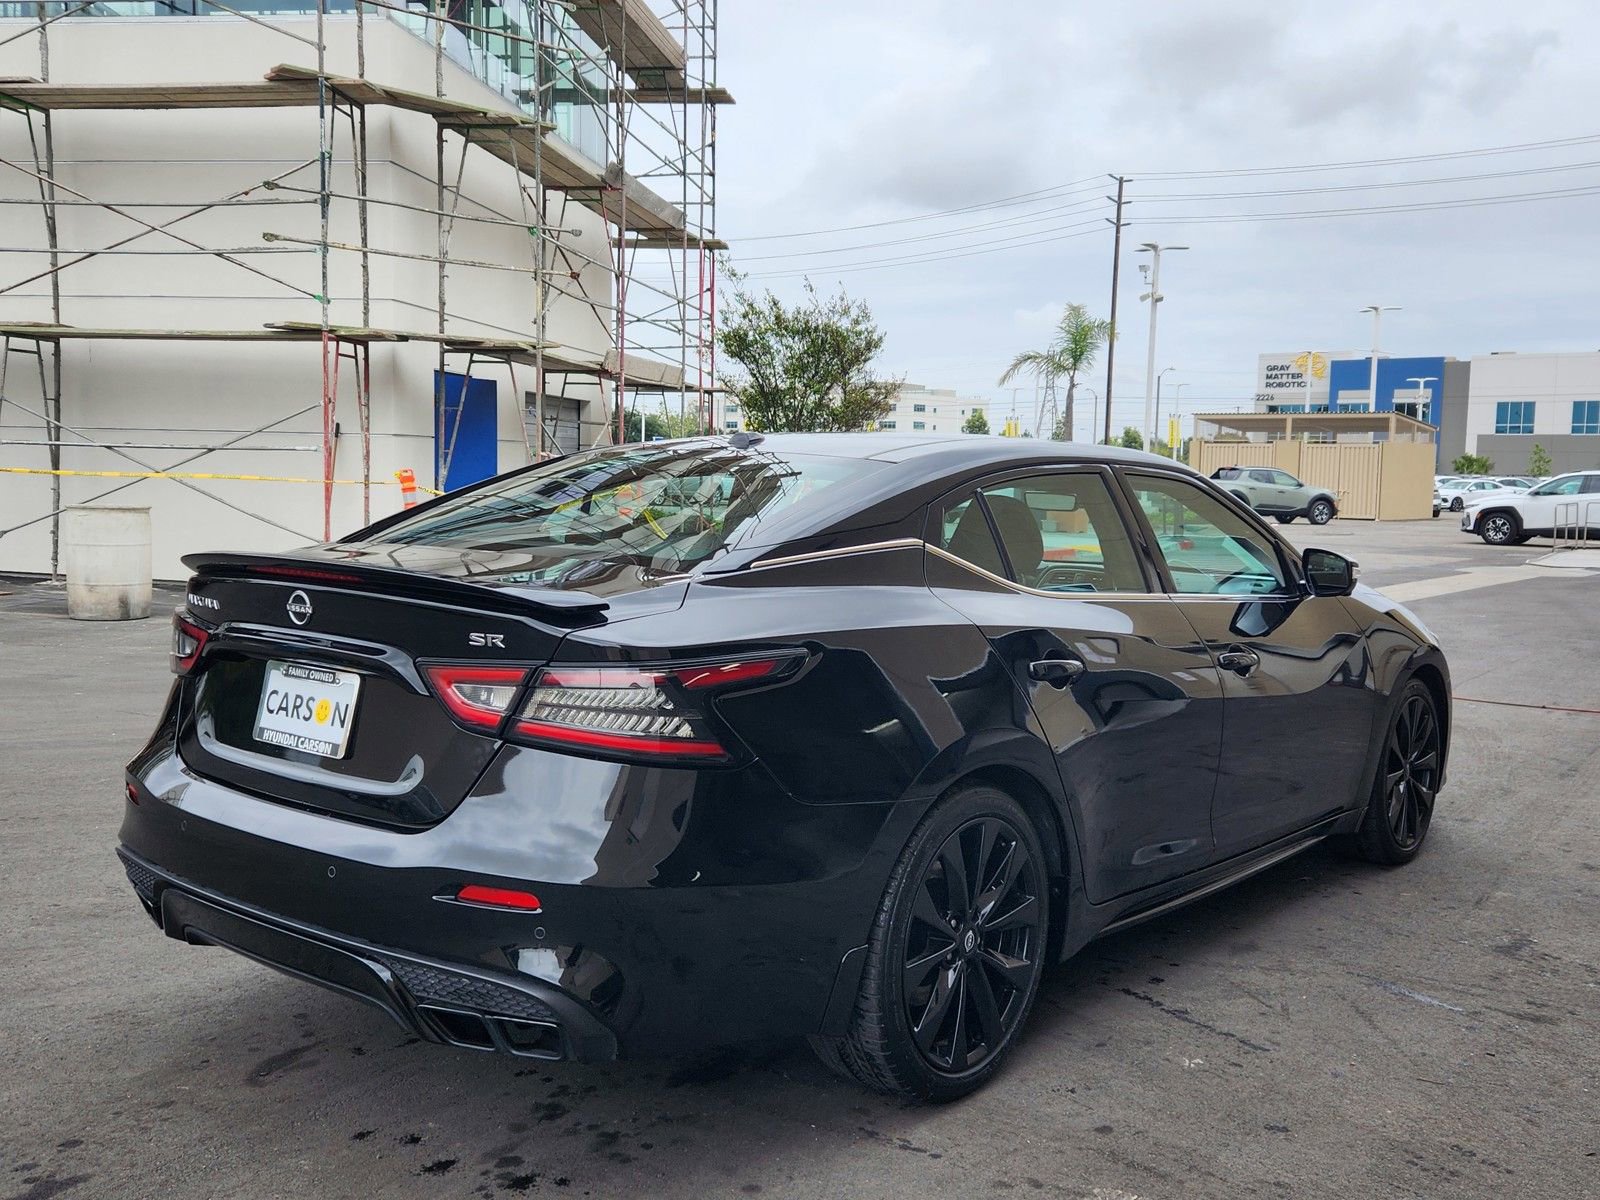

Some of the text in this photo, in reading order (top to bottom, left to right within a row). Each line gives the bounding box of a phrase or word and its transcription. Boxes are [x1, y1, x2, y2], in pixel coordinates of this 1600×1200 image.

[1265, 372, 1304, 380] MATTER
[1266, 364, 1291, 372] GRAY
[468, 632, 506, 648] SR
[288, 666, 334, 682] FAMILY OWNED
[263, 729, 333, 755] HYUNDAI CARSON
